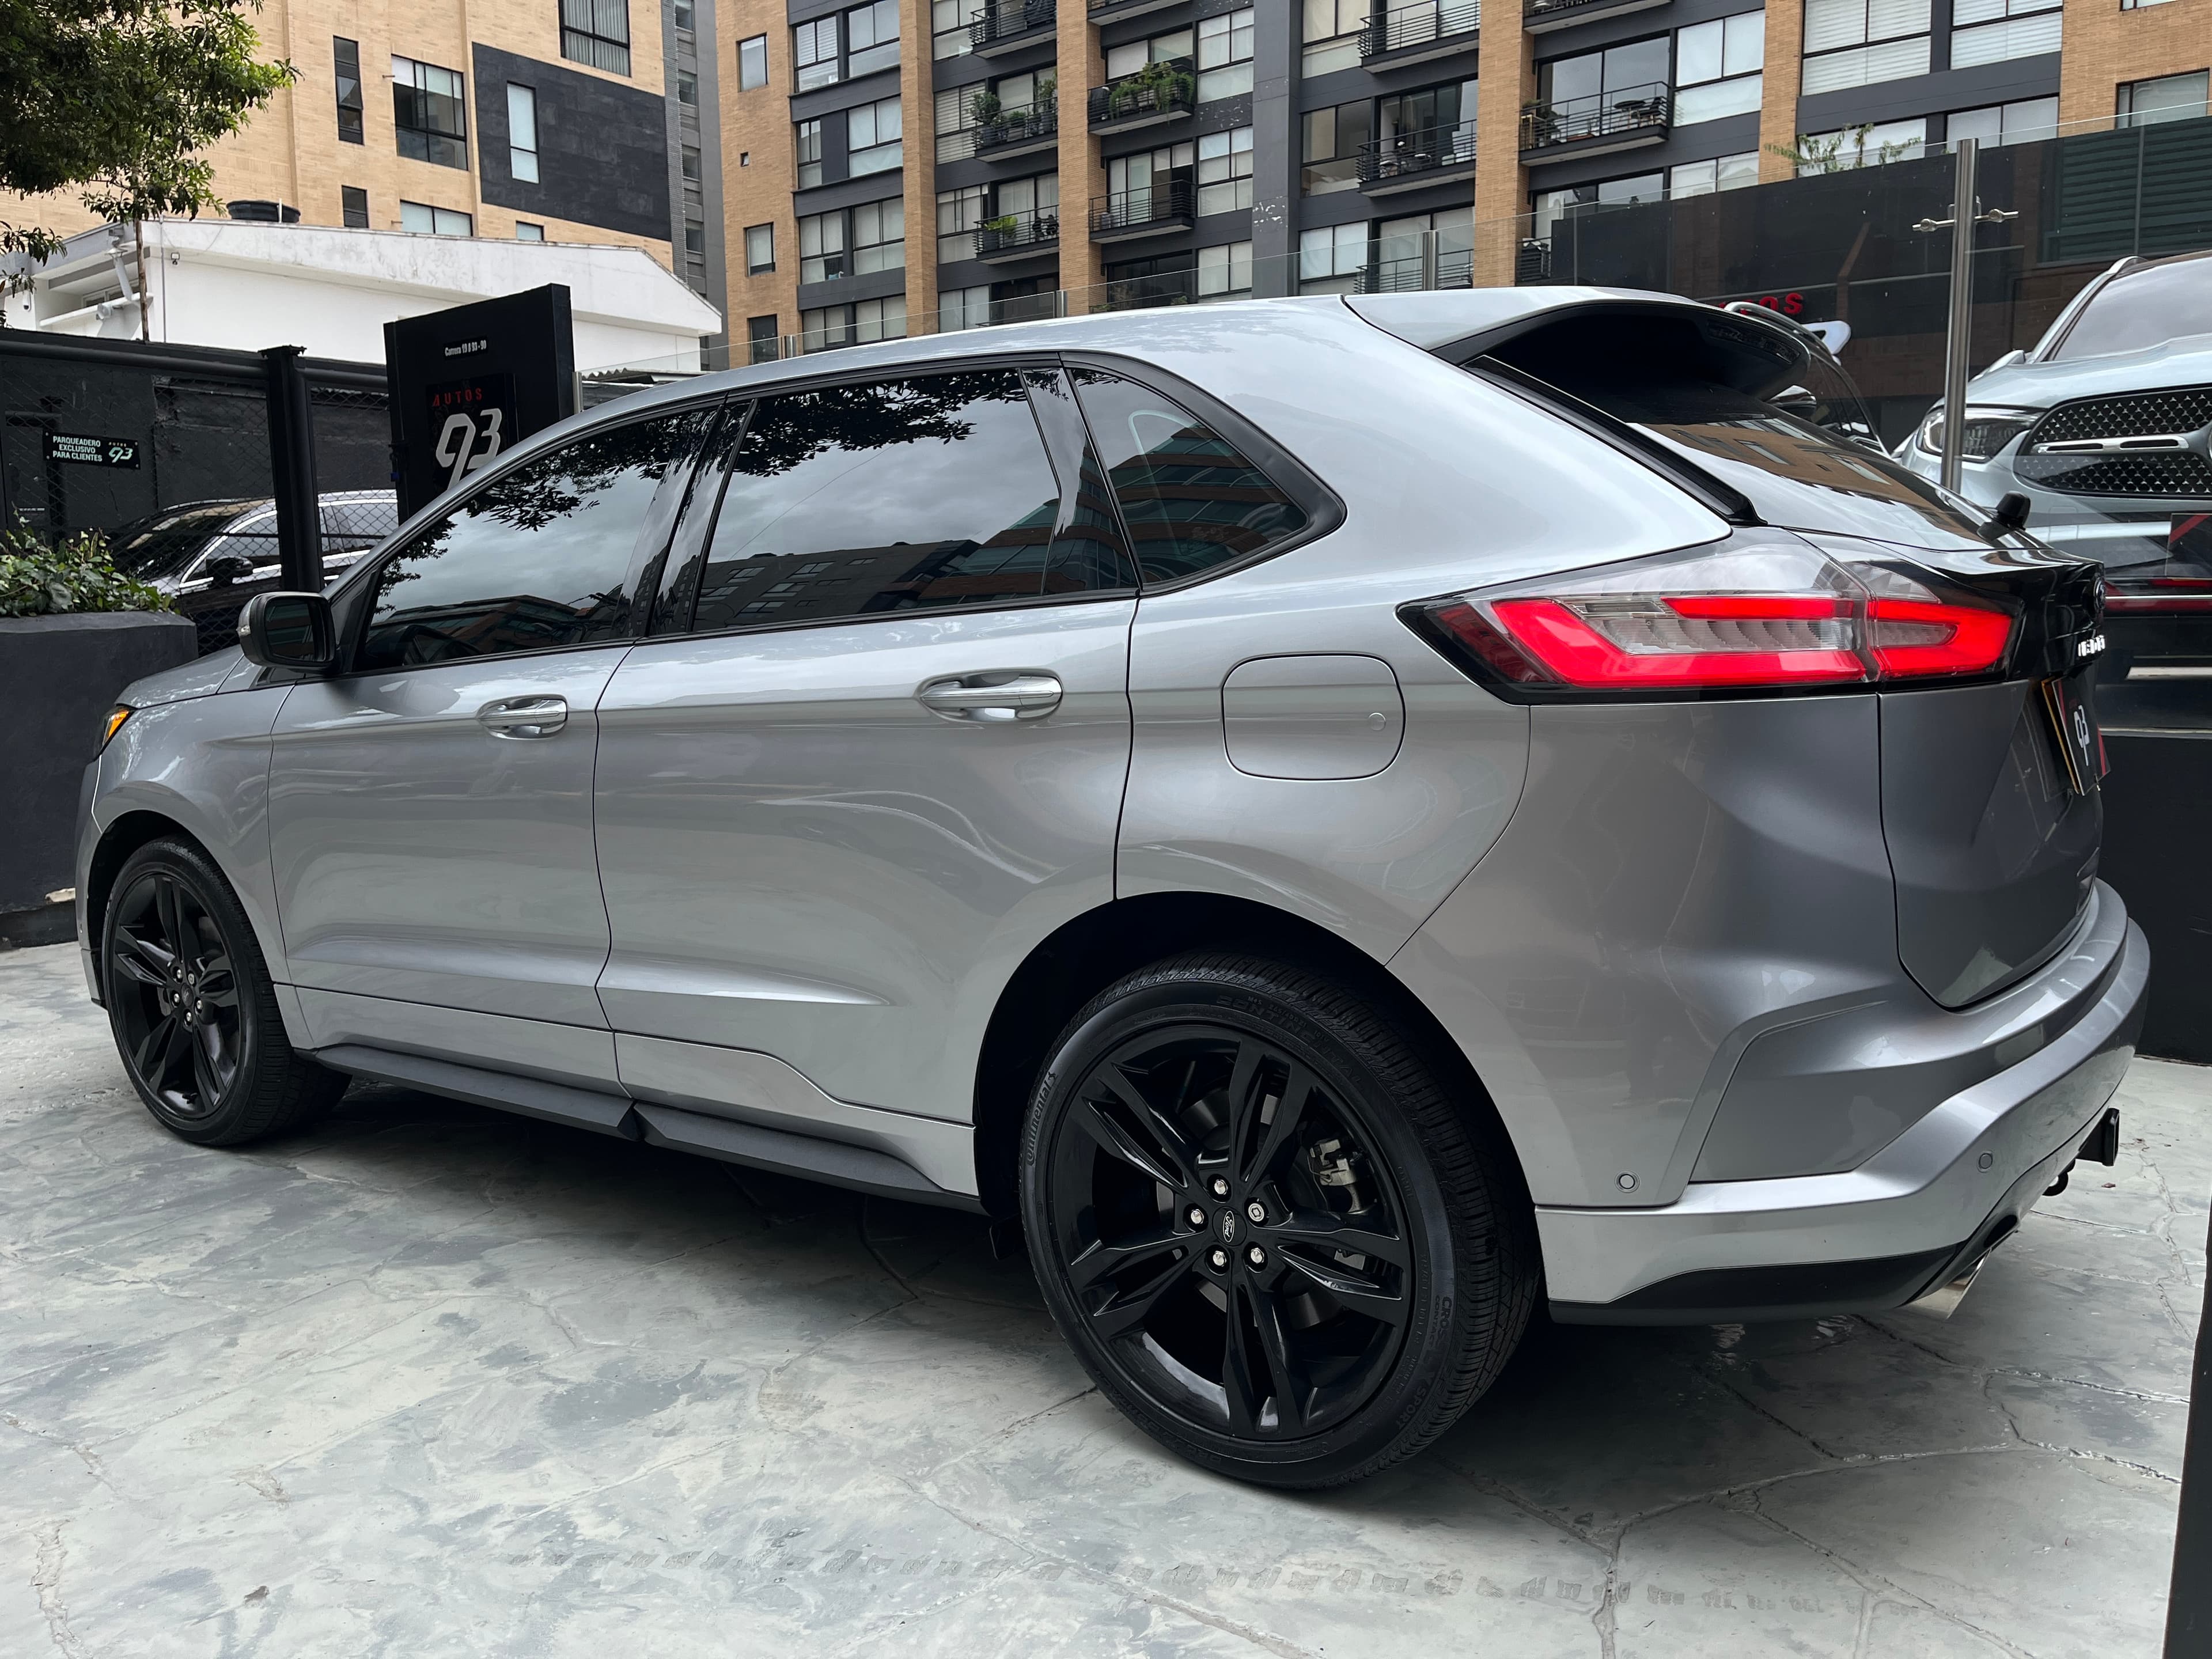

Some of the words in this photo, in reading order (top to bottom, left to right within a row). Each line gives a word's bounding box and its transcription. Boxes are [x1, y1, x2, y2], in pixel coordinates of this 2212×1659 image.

[433, 388, 482, 406] AUTOS
[53, 436, 101, 447] PARQUEADERO
[59, 444, 96, 453] EXCLUSIVO
[436, 408, 502, 491] 93
[53, 450, 70, 459] PARA
[71, 453, 102, 461] CLIENTES
[108, 447, 133, 463] 93
[1027, 1080, 1052, 1166] Continental
[1224, 1215, 1234, 1238] Ford
